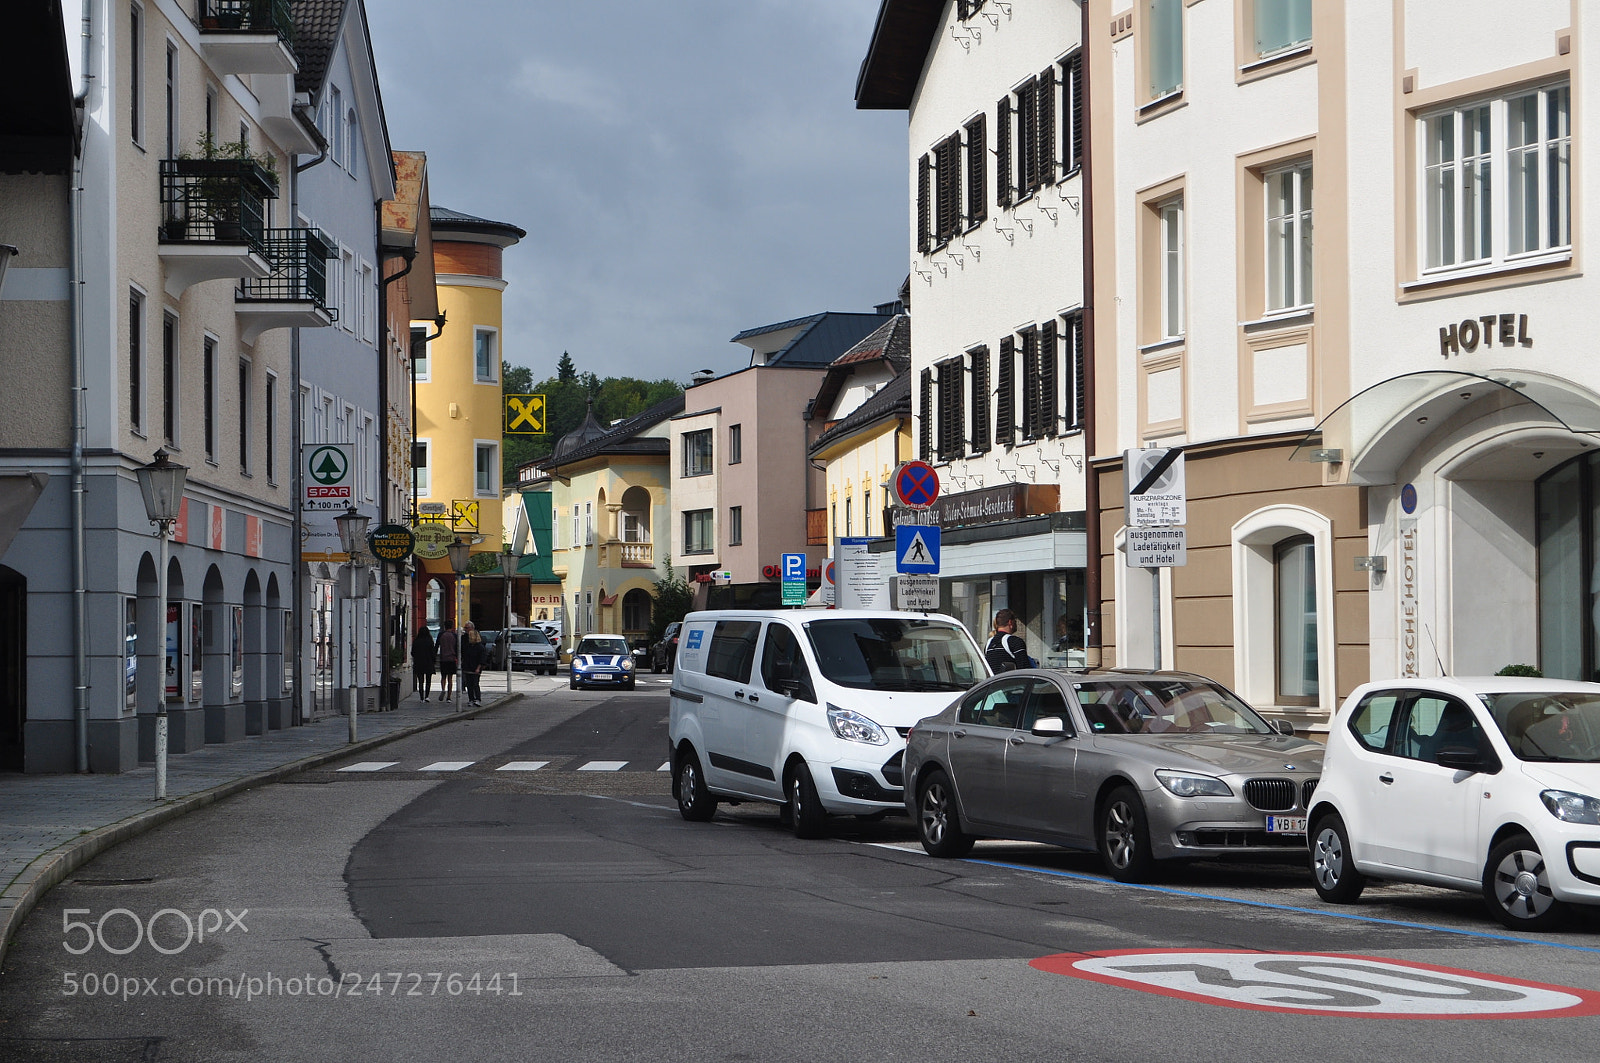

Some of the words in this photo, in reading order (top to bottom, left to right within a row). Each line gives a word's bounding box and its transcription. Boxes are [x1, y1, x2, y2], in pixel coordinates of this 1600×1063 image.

[1439, 312, 1533, 359] HOTEL
[309, 488, 349, 497] SPAR
[433, 532, 453, 544] Post
[1130, 531, 1184, 541] ausgenommen
[380, 546, 402, 559] 3322
[1133, 542, 1181, 553] Ladetätigkeit
[1140, 555, 1153, 563] und
[1156, 555, 1175, 563] Hotel
[1404, 529, 1414, 598] HOTEL
[787, 555, 802, 576] P
[549, 595, 560, 603] in
